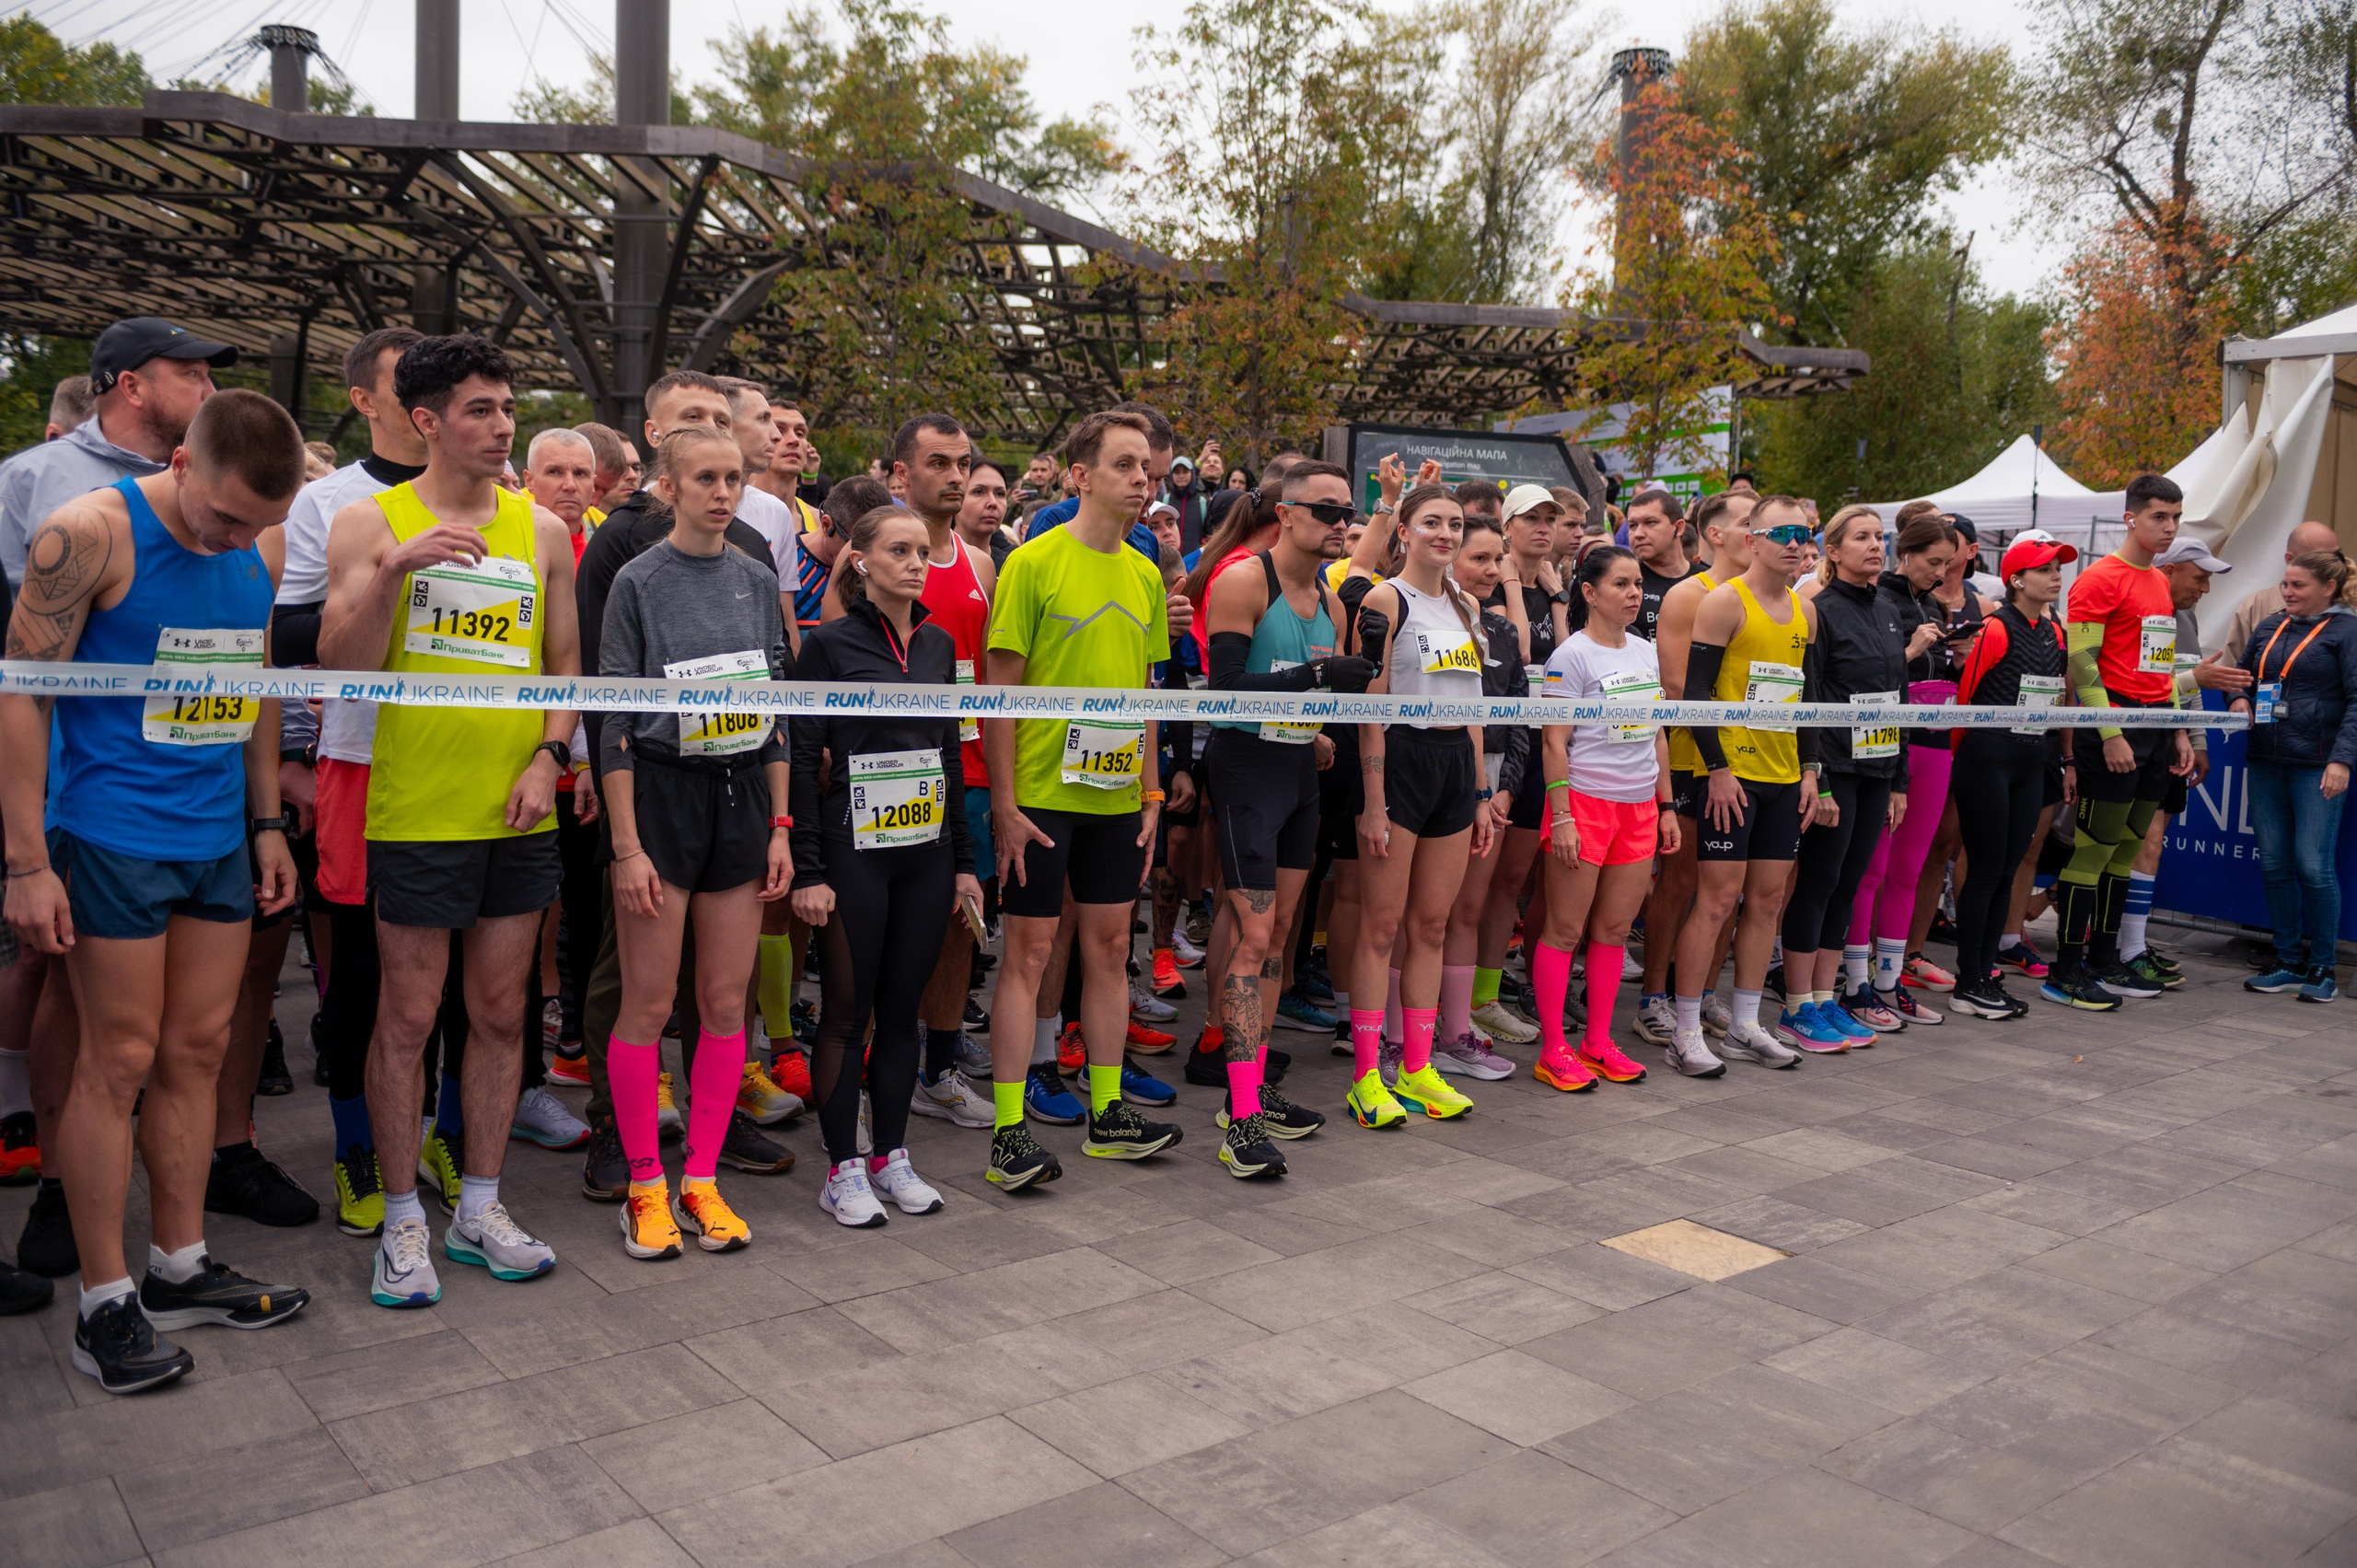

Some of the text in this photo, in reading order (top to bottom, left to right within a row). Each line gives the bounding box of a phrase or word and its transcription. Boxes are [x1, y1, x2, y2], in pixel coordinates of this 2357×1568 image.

[1407, 445, 1506, 460] НАВІГАЦІЙНА МАПА
[1467, 462, 1480, 470] map
[446, 563, 479, 572] ARMOUR
[433, 607, 510, 642] 11392
[443, 644, 505, 659] ПриватБанк
[1434, 649, 1477, 668] 11686
[693, 663, 716, 671] UNDER
[695, 667, 724, 676] ARMOUR
[173, 696, 243, 721] 12153
[340, 684, 394, 700] RUN
[517, 687, 567, 703] RUN
[679, 690, 723, 705] RUN
[825, 692, 866, 707] RUN
[959, 695, 998, 710] RUN
[1083, 698, 1120, 712] RUN
[1197, 700, 1229, 714] RUN
[1301, 703, 1332, 715] RUN
[1399, 704, 1428, 717] RUN
[1489, 705, 1517, 718] RUN
[1573, 706, 1598, 719] RUN
[1651, 708, 1675, 720] RUN
[1724, 709, 1747, 721] RUN
[1792, 711, 1814, 721] RUN
[1856, 711, 1876, 722] RUN
[1917, 712, 1936, 723] RUN
[1974, 712, 1991, 723] RUN
[2027, 713, 2045, 723] RUN
[2078, 714, 2094, 723] RUN
[2126, 714, 2142, 724] RUN
[699, 713, 758, 737] 11808
[184, 730, 238, 741] ПриватБанк
[714, 738, 758, 751] ПриватБанк
[1081, 749, 1132, 772] 11352
[919, 781, 928, 796] B
[871, 802, 931, 828] 12088
[886, 832, 929, 843] ПриватБанк
[1793, 1022, 1813, 1037] HOKA
[1265, 1110, 1286, 1121] ance
[1109, 1128, 1142, 1137] balance
